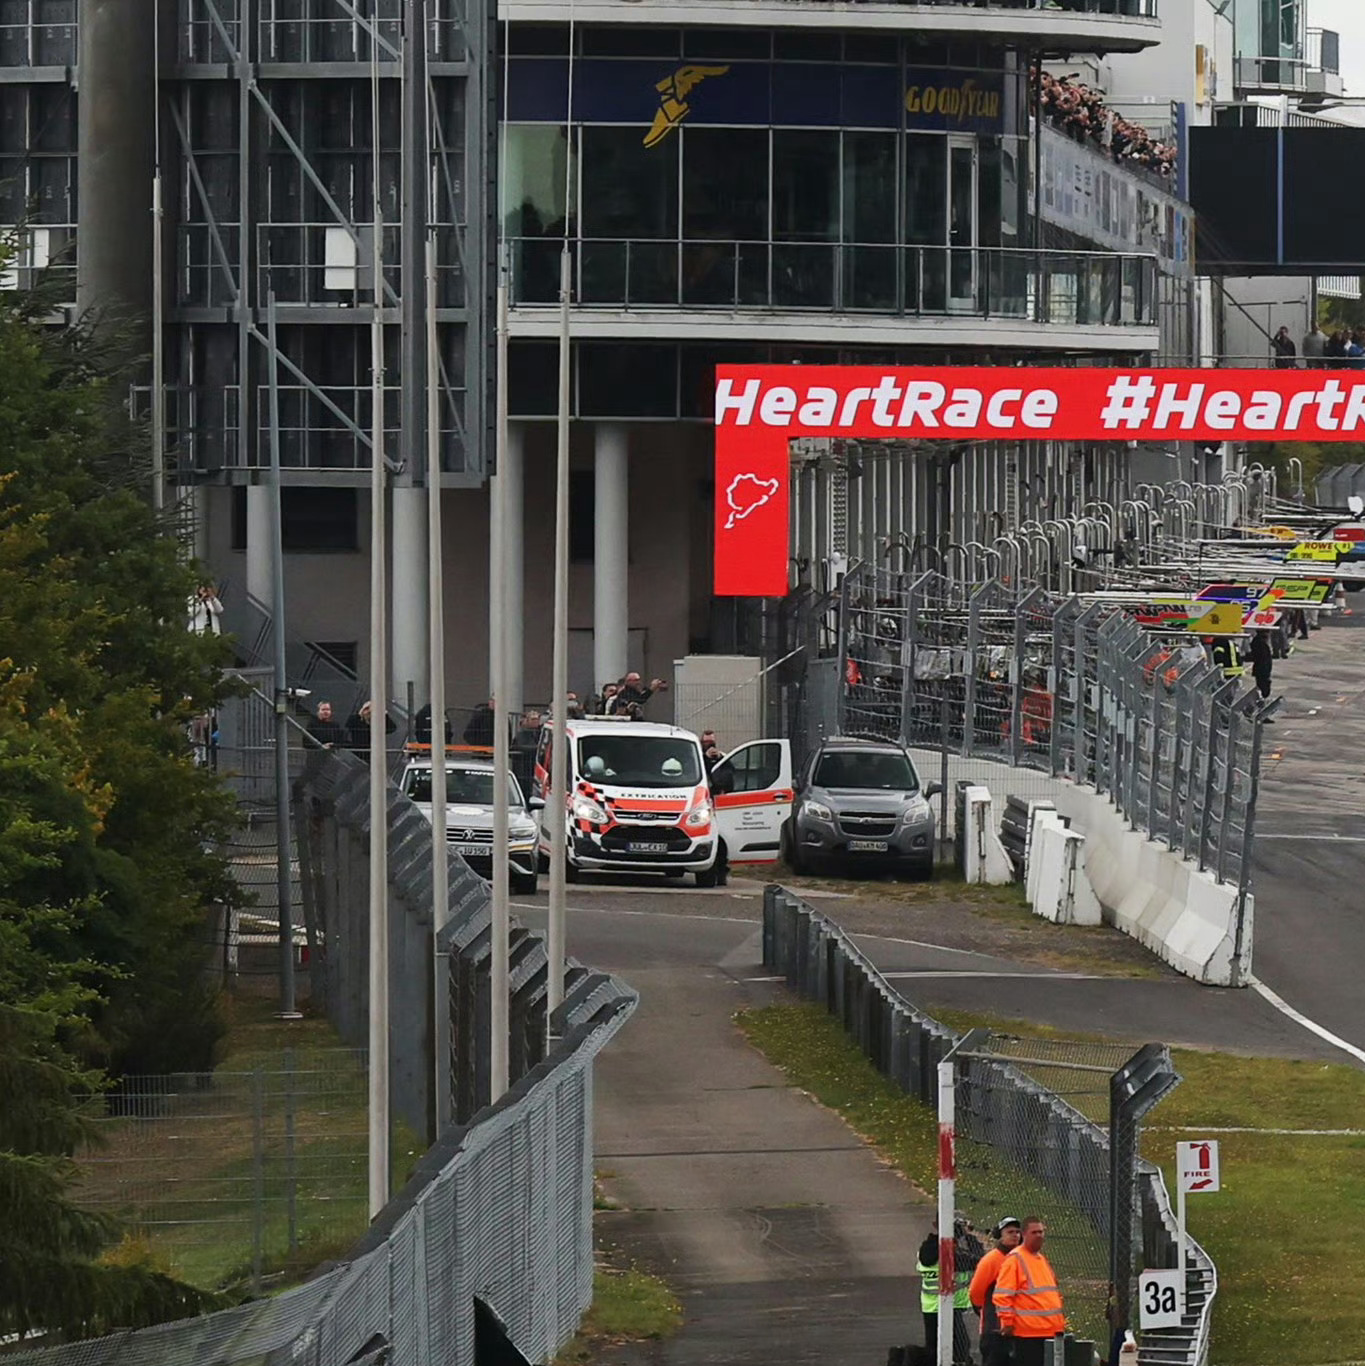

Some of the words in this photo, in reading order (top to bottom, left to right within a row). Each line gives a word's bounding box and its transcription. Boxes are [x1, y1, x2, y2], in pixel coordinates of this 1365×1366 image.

[905, 82, 998, 121] GOODYEAR
[1304, 542, 1333, 550] ROWE
[1184, 1170, 1211, 1178] FIRE
[1144, 1281, 1176, 1315] 3a
